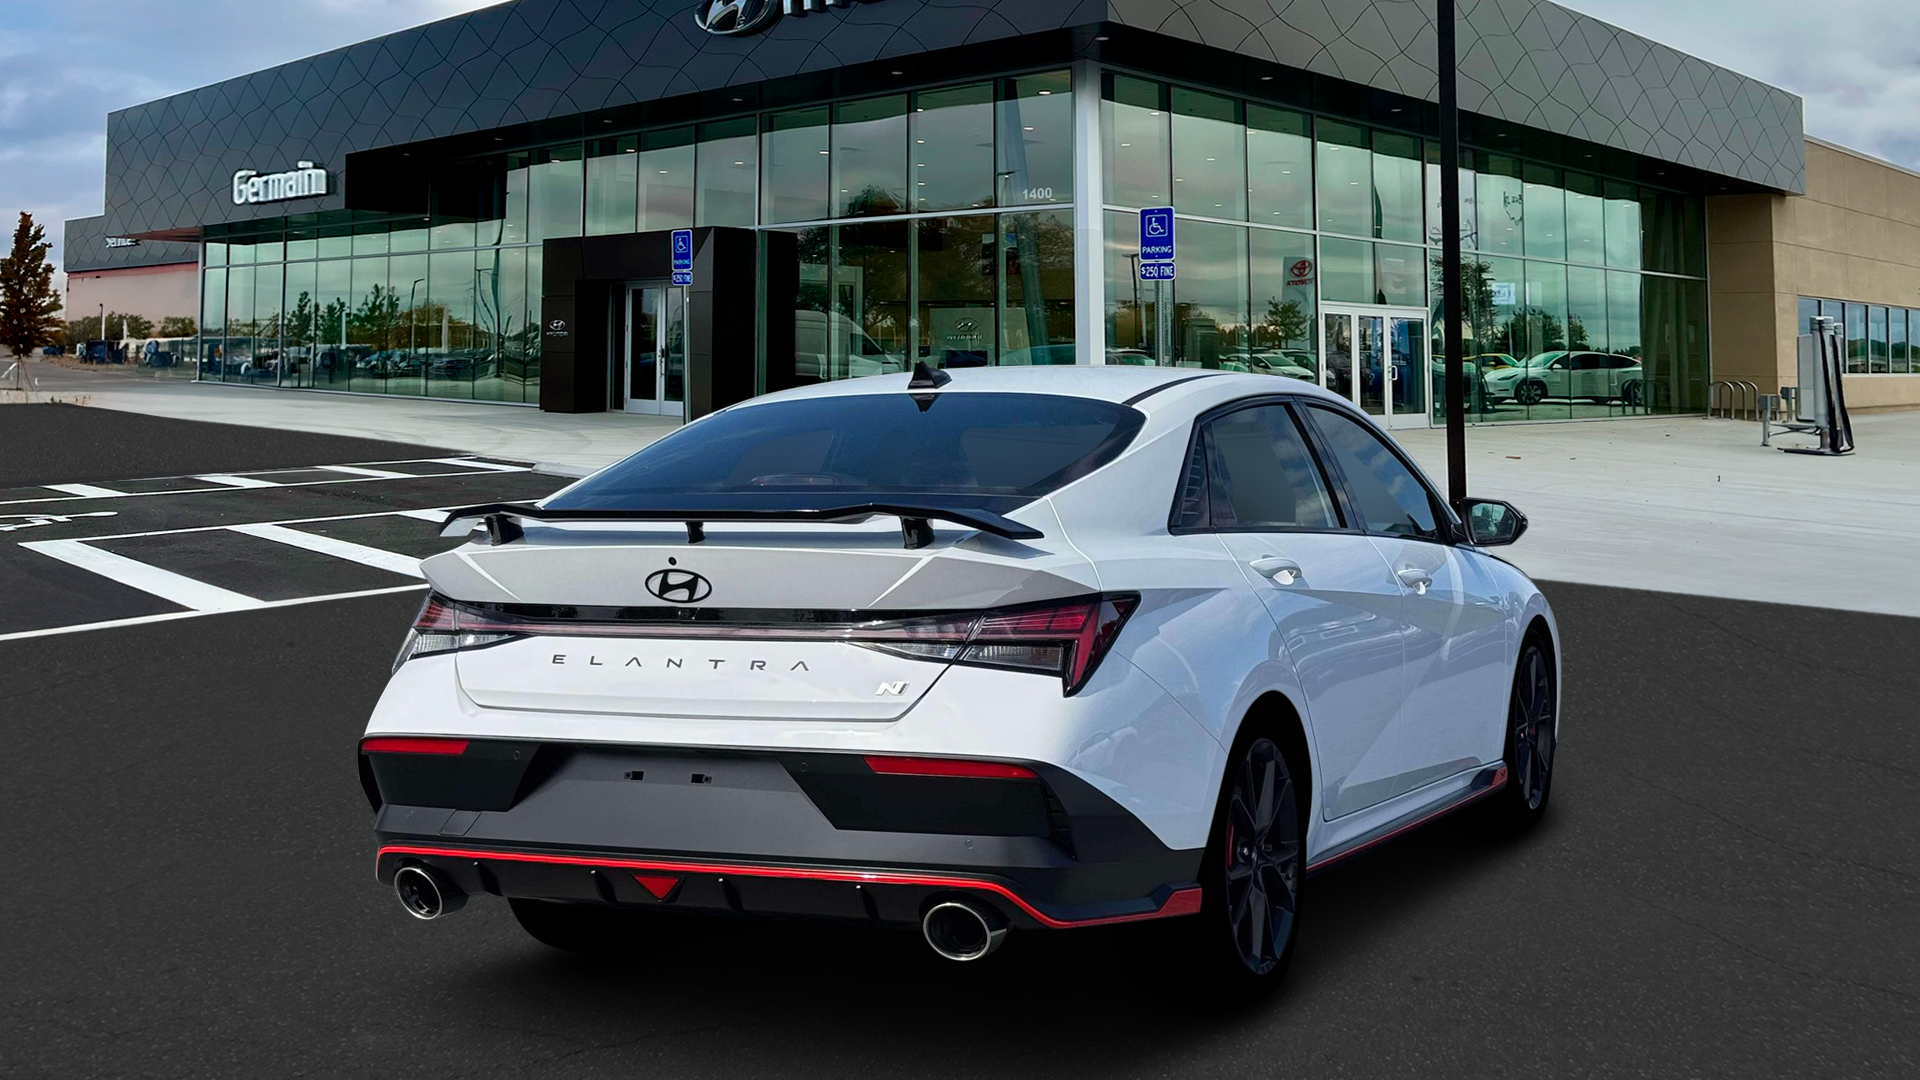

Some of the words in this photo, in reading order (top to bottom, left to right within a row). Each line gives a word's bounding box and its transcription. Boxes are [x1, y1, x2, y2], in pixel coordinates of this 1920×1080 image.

[233, 161, 327, 205] Germain
[1022, 187, 1052, 200] 1400
[1142, 245, 1172, 254] PARKING
[1141, 265, 1159, 277] $250
[1160, 265, 1174, 277] FINE
[551, 653, 810, 672] ELANTRA
[875, 681, 910, 696] N
